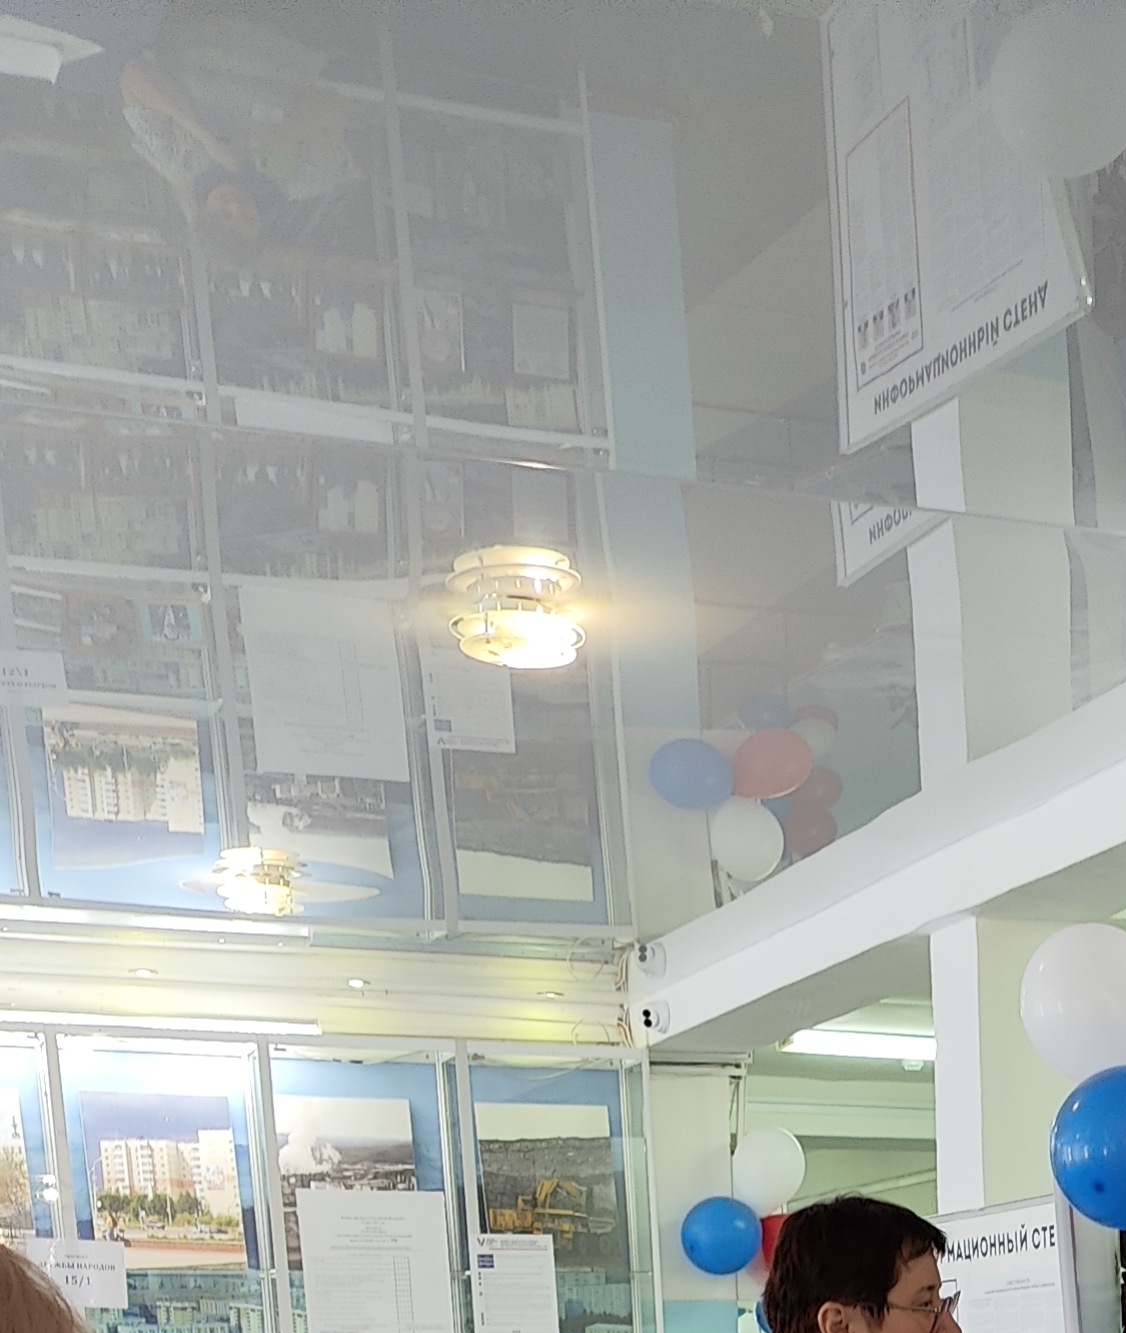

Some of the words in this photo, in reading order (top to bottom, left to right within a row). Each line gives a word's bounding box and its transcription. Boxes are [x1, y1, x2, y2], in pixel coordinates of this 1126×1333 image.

[941, 1223, 1028, 1264] МАЦИОННЫЙ
[1031, 1224, 1056, 1250] СТЕ
[77, 1262, 116, 1272] НАРОДОВ
[65, 1275, 91, 1288] 15/1
